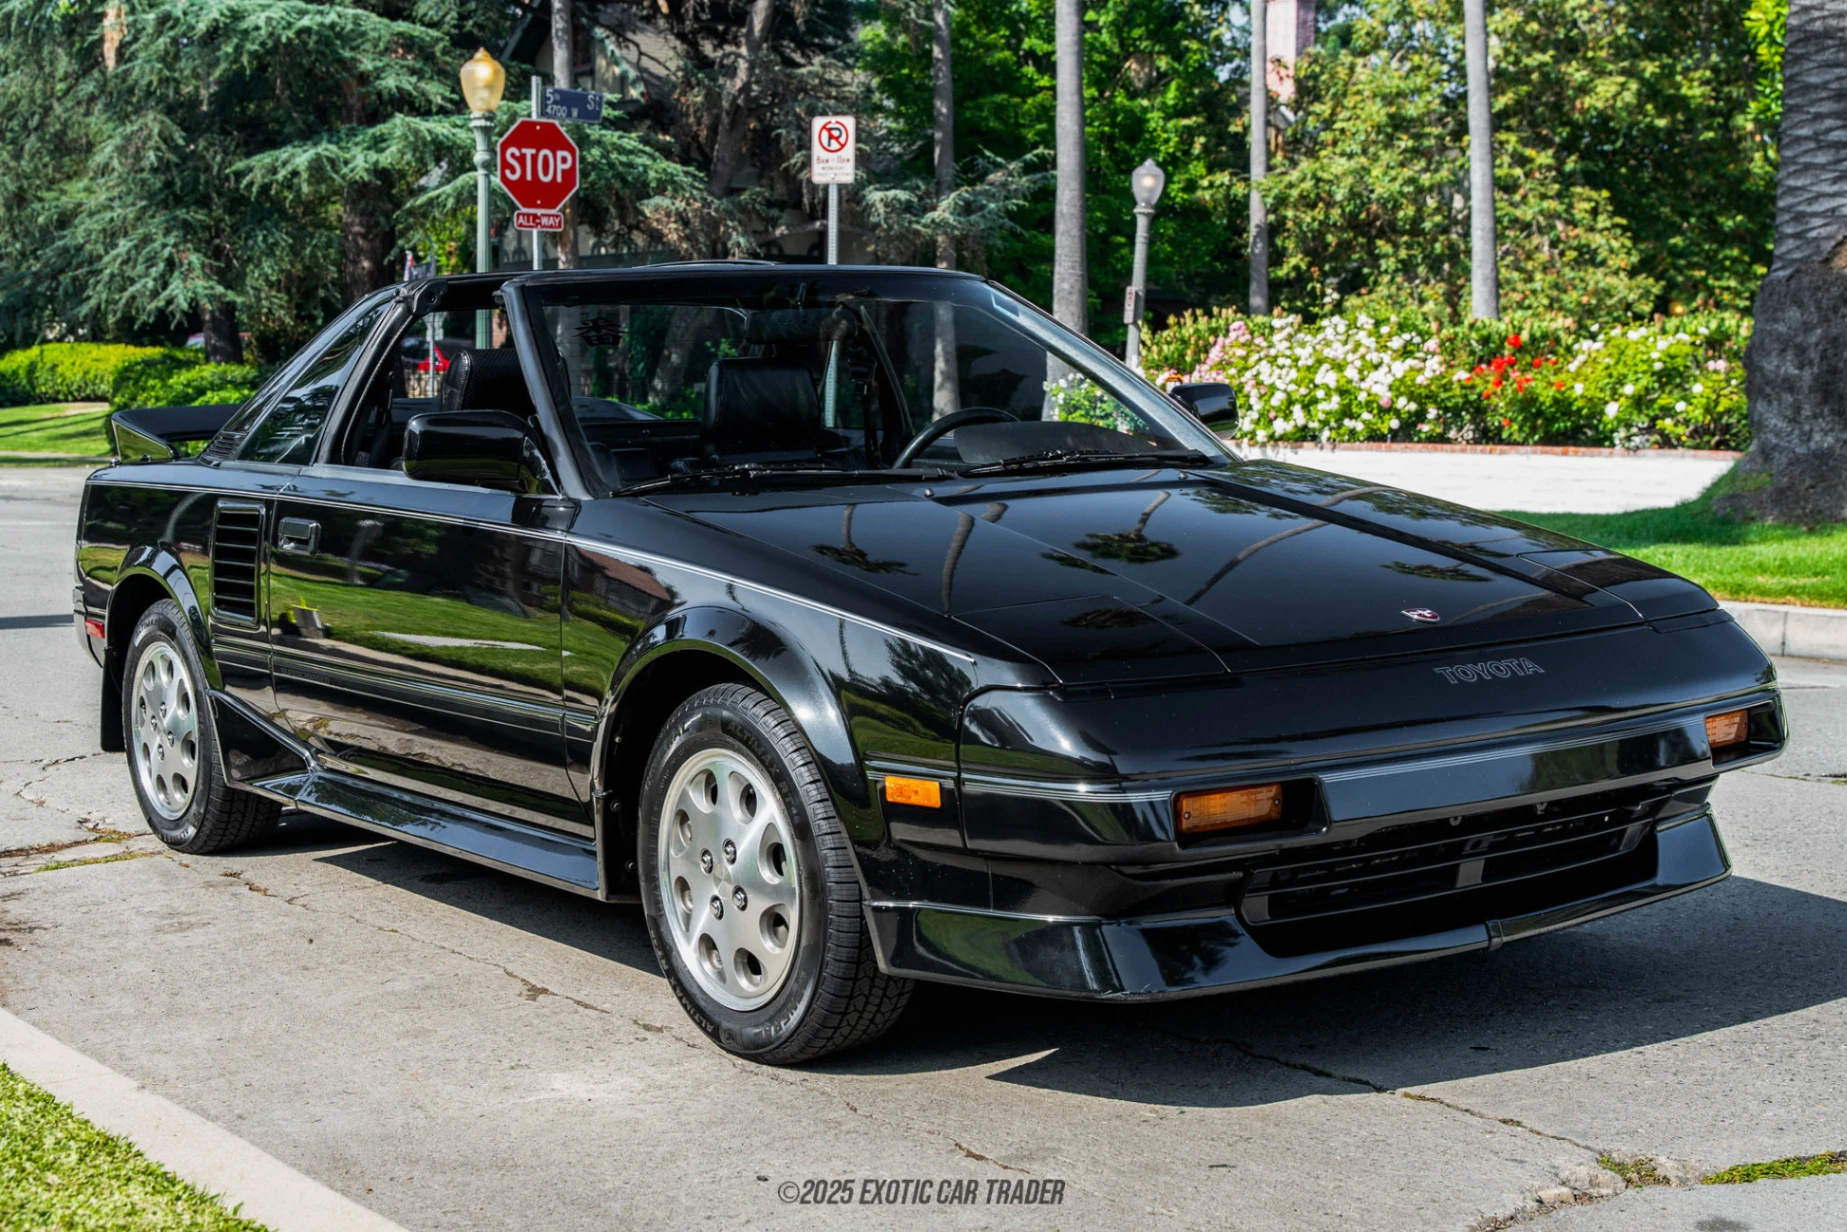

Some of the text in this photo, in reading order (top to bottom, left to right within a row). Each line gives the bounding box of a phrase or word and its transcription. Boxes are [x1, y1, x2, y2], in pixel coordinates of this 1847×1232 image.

[545, 104, 568, 118] 4700
[504, 146, 573, 183] STOP
[517, 214, 561, 227] ALL-WAY
[1432, 657, 1545, 684] TOYOTA
[727, 722, 780, 777] ALTIMAX
[669, 976, 715, 1033] ALTIMAX
